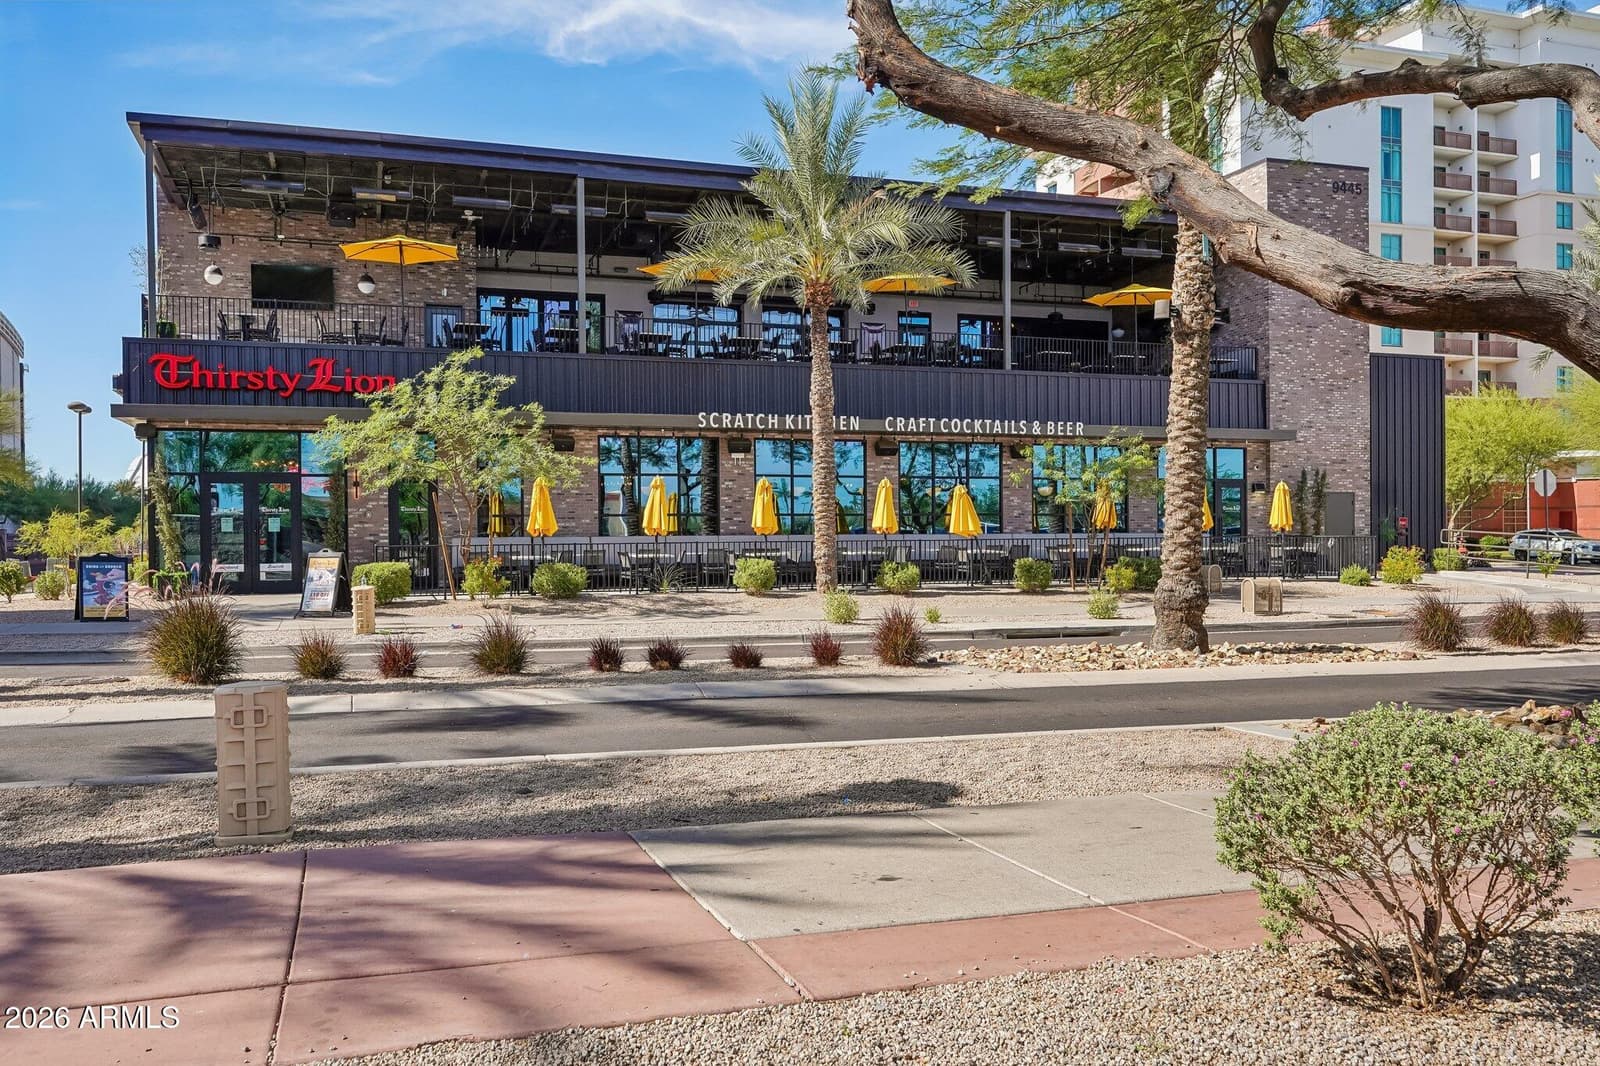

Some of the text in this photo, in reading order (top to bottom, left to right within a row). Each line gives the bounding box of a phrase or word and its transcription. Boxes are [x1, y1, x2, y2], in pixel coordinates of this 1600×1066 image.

[1332, 181, 1362, 195] 9445
[148, 353, 396, 397] Thirsty Lion
[698, 412, 1084, 436] SCRATCH KITEN CRAFT COCKTAILS & BEER
